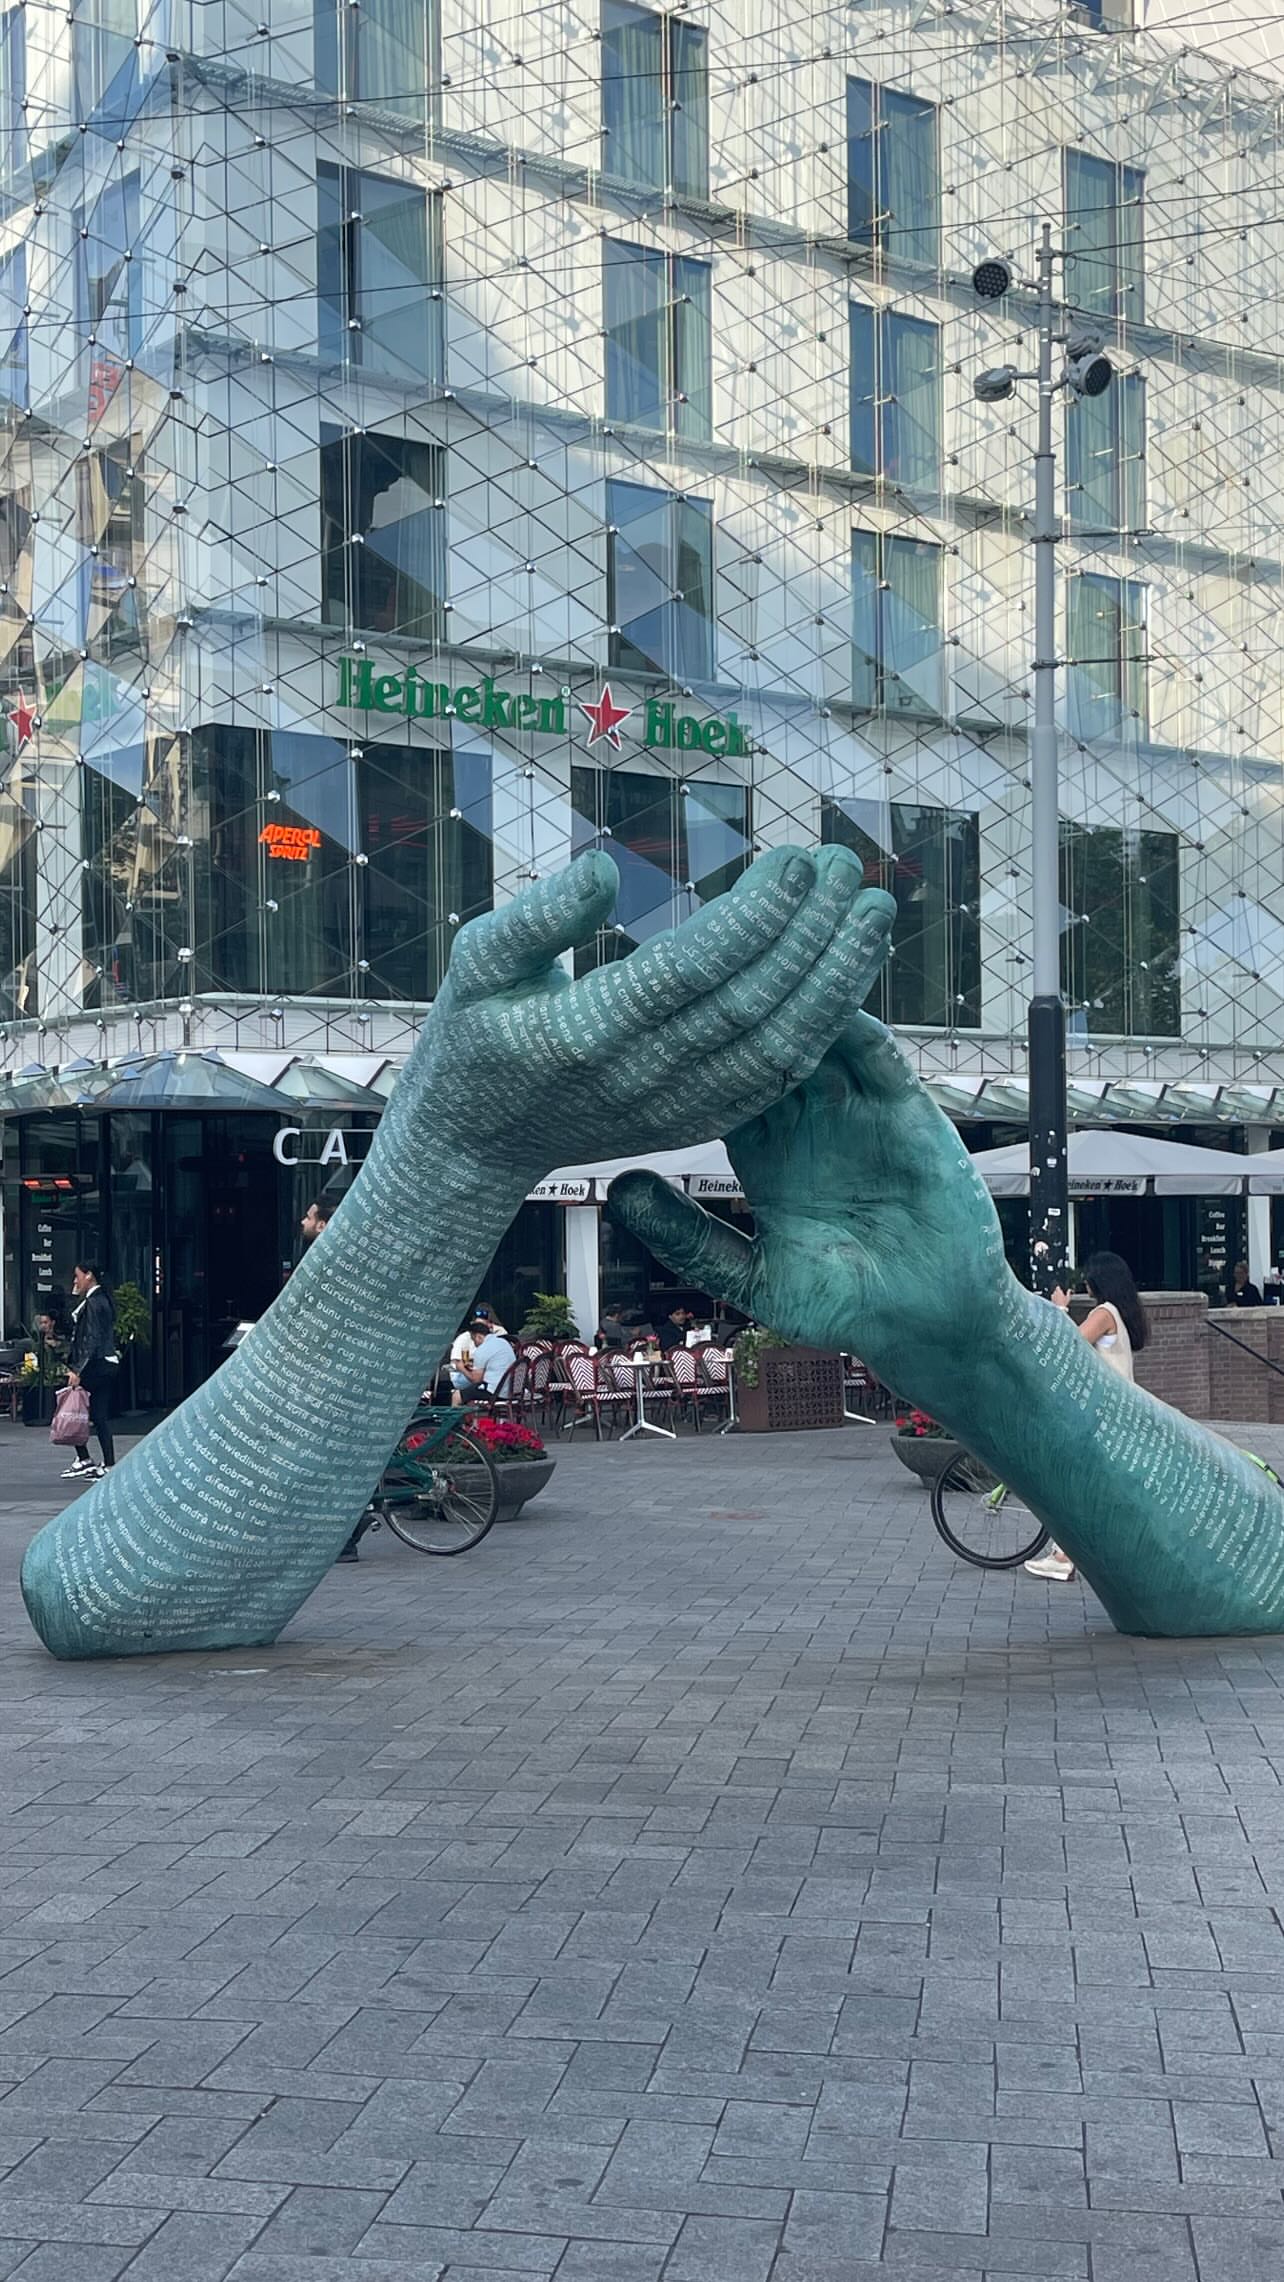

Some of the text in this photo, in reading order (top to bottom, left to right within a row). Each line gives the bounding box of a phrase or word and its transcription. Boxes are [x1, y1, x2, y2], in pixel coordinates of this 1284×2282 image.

[336, 656, 753, 758] Heineken Hoek
[258, 823, 322, 848] APEROL
[268, 844, 310, 862] SPRITZ
[556, 1015, 575, 1044] sens
[582, 1029, 598, 1048] les
[560, 1183, 585, 1196] Hoek
[316, 1300, 342, 1321] bunu
[313, 1353, 333, 1369] zeg
[337, 1346, 356, 1363] rug
[163, 1485, 180, 1504] che
[179, 1502, 209, 1525] andrà
[211, 1519, 240, 1538] tutto
[197, 1489, 233, 1515] ascolto
